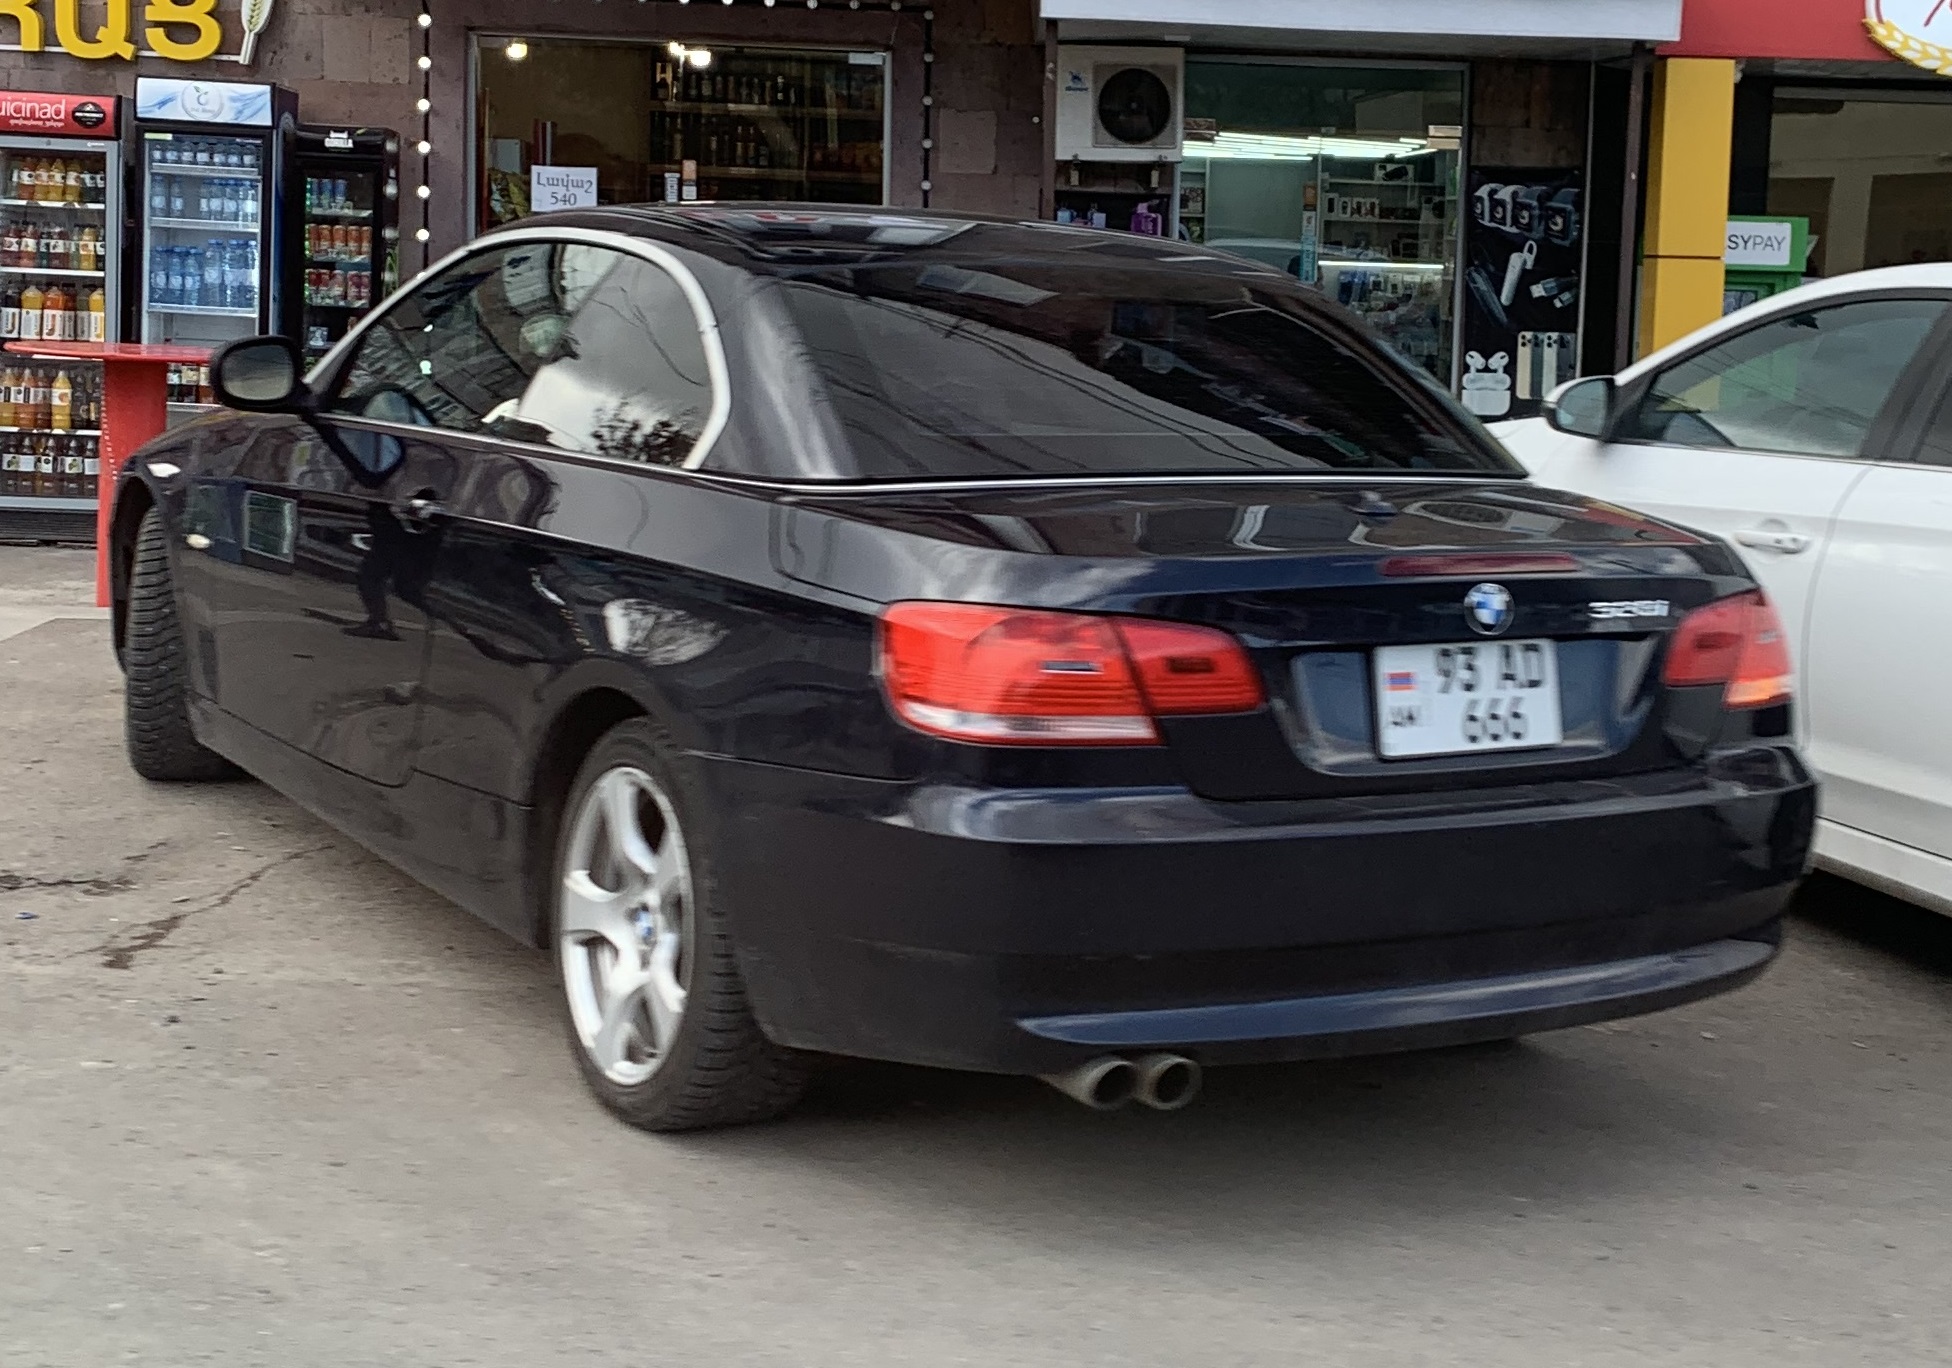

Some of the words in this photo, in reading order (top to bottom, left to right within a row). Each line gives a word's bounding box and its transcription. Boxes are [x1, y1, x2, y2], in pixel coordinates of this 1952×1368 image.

[550, 191, 577, 206] 540
[1727, 233, 1786, 252] SYPAY
[1461, 696, 1529, 743] 666
